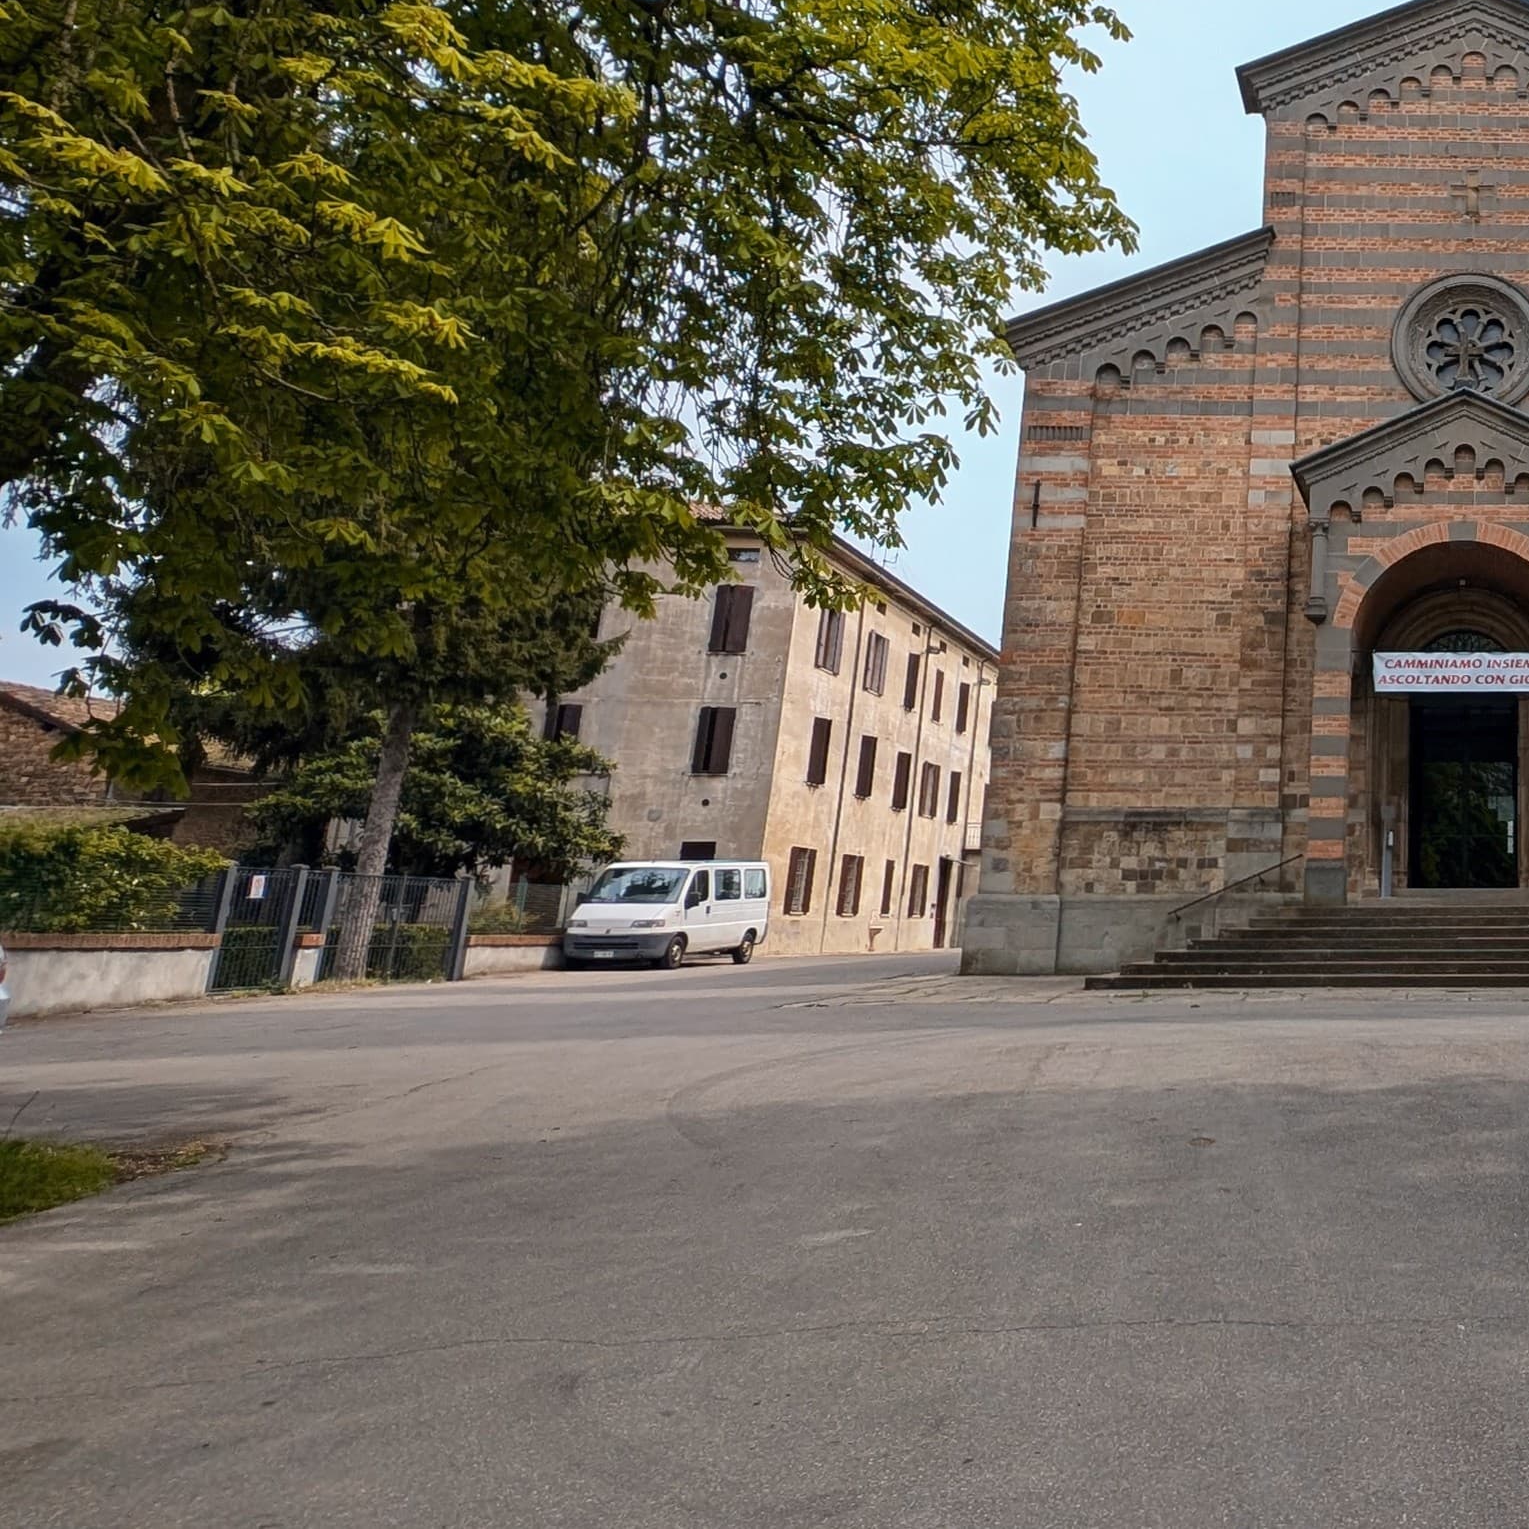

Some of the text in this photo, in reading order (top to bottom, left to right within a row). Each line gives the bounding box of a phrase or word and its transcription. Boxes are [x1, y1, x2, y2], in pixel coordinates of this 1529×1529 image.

[1385, 659, 1482, 669] CAMMINIAMO
[1378, 675, 1471, 685] ASCOLTANDO
[1475, 675, 1506, 684] CON
